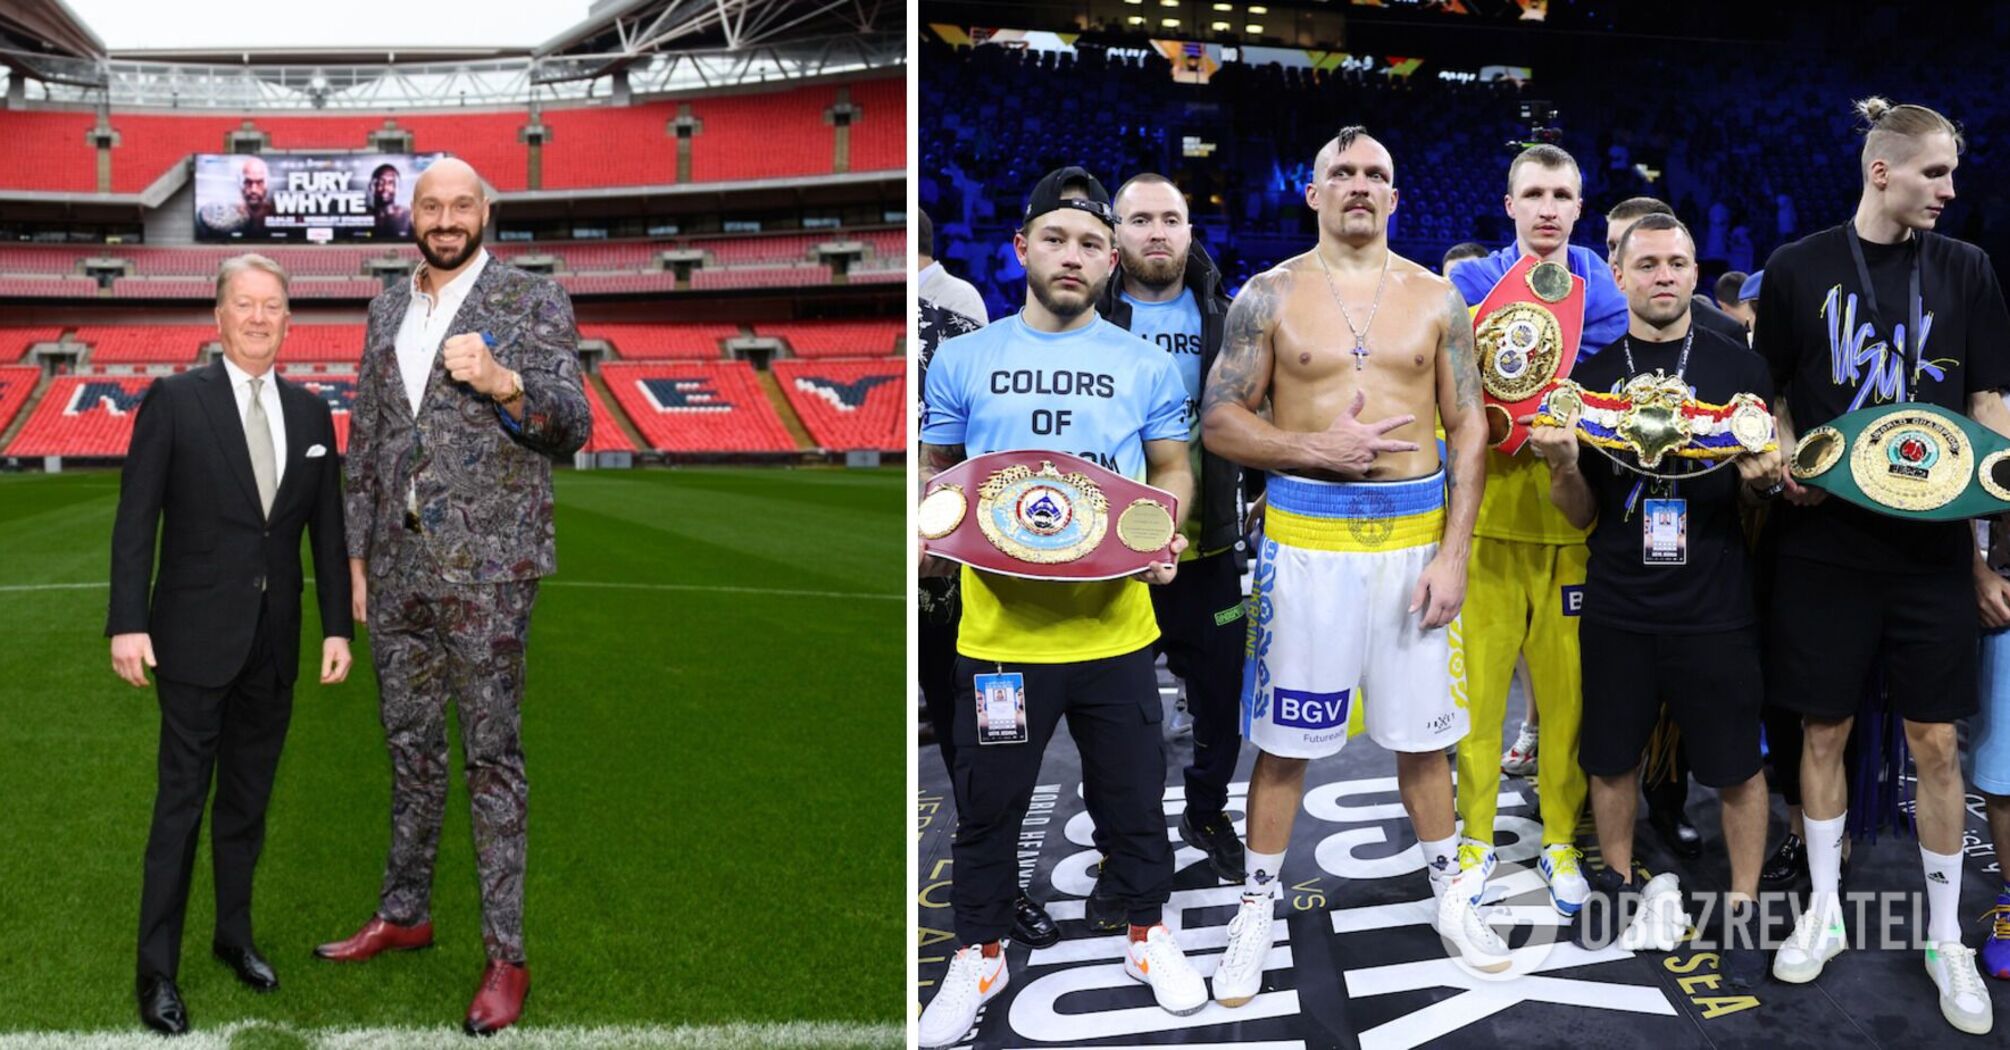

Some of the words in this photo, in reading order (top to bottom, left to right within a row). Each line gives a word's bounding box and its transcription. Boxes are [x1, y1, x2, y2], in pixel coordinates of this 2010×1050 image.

[288, 171, 353, 191] FURY
[273, 191, 367, 213] WHYTE
[990, 370, 1115, 398] COLORS
[1031, 409, 1072, 435] OF
[1873, 418, 1907, 438] WORLD
[1912, 418, 1959, 449] CHAMPION
[1244, 579, 1262, 661] UKRAINE
[1281, 697, 1343, 723] BGV
[1022, 784, 1061, 826] WORLD
[1291, 877, 1326, 912] VS
[1663, 952, 1761, 1020] SEA
